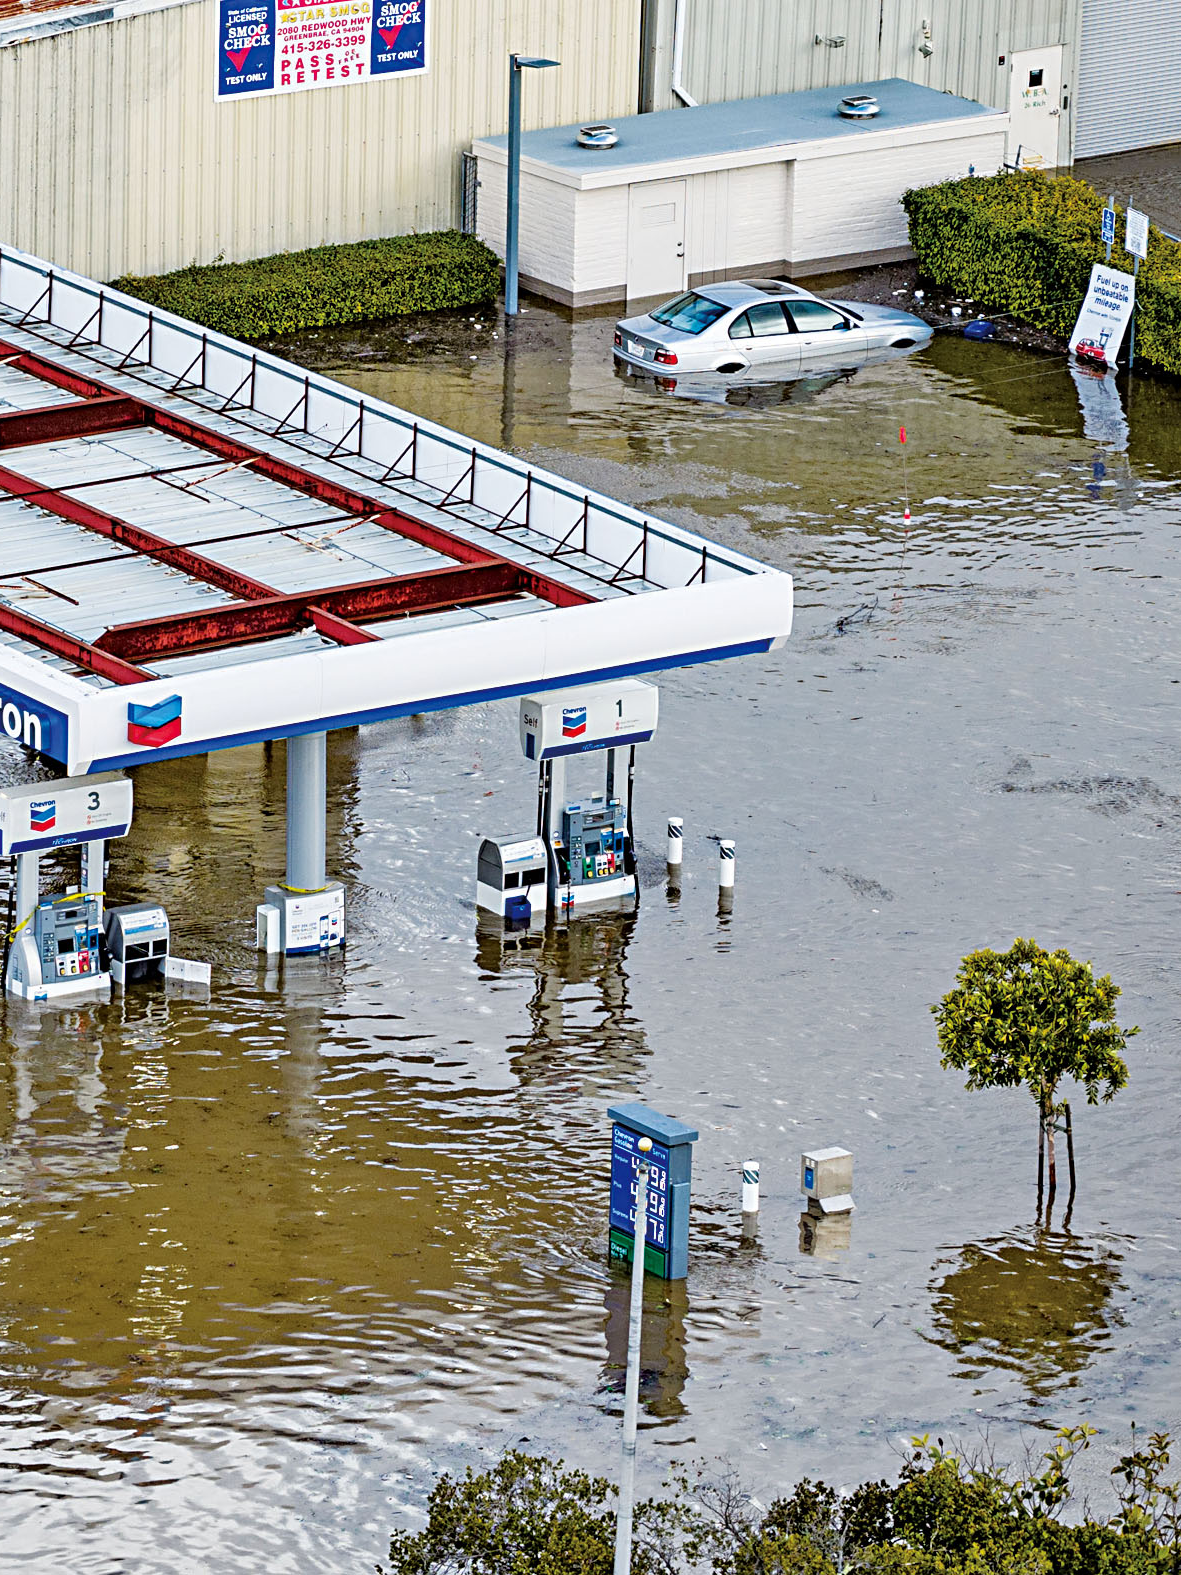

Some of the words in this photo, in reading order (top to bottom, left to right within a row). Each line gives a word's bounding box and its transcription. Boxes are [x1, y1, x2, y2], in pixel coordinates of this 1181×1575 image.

[289, 8, 324, 23] STAR
[381, 2, 418, 16] SMOG
[229, 12, 267, 23] LICENSED
[377, 12, 421, 28] CHECK
[229, 24, 268, 38] SMOG
[277, 27, 299, 36] 2080
[302, 20, 348, 32] REDWOOD
[351, 16, 371, 25] HWY
[224, 35, 271, 50] CHECK
[282, 35, 365, 55] 415-326-3399
[282, 53, 334, 72] PASS
[377, 53, 396, 62] TEST
[398, 50, 418, 60] ONLY
[226, 75, 245, 85] TEST
[246, 72, 267, 83] ONLY
[282, 63, 365, 86] RETEST
[1097, 275, 1111, 286] Fuel
[1112, 280, 1119, 290] up
[1121, 284, 1129, 292] on
[1094, 286, 1129, 303] unbeatable
[563, 707, 587, 715] Chevron
[616, 700, 622, 718] 1
[524, 714, 538, 728] Self
[30, 800, 56, 809] Chevron
[88, 792, 100, 811] 3
[615, 1129, 634, 1143] Chevron
[653, 1148, 665, 1160] Serve
[632, 1157, 659, 1187] 49
[631, 1183, 658, 1213] 49
